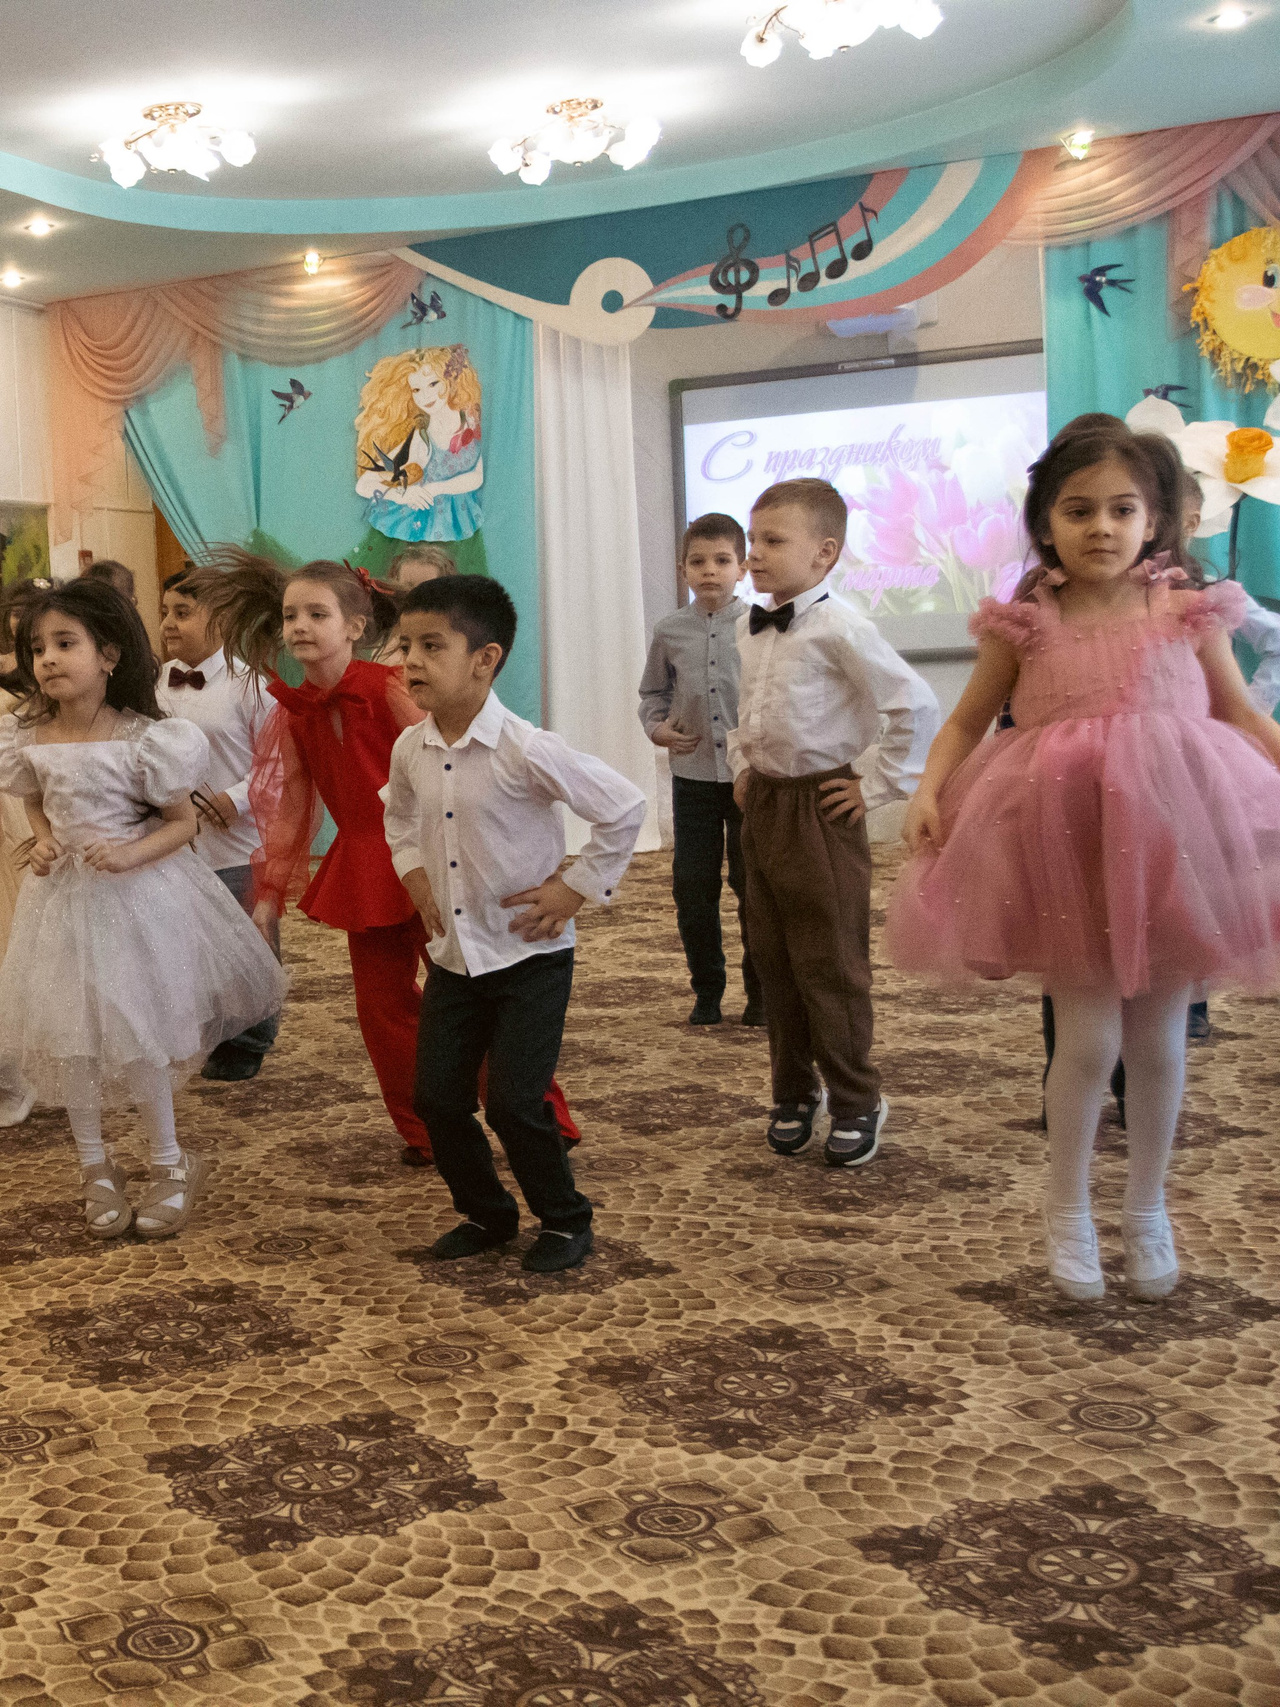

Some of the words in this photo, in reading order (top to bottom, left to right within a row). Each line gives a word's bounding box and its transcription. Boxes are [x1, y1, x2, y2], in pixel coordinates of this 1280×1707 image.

[701, 430, 757, 482] С
[763, 423, 941, 482] праздником
[840, 564, 940, 611] марта
